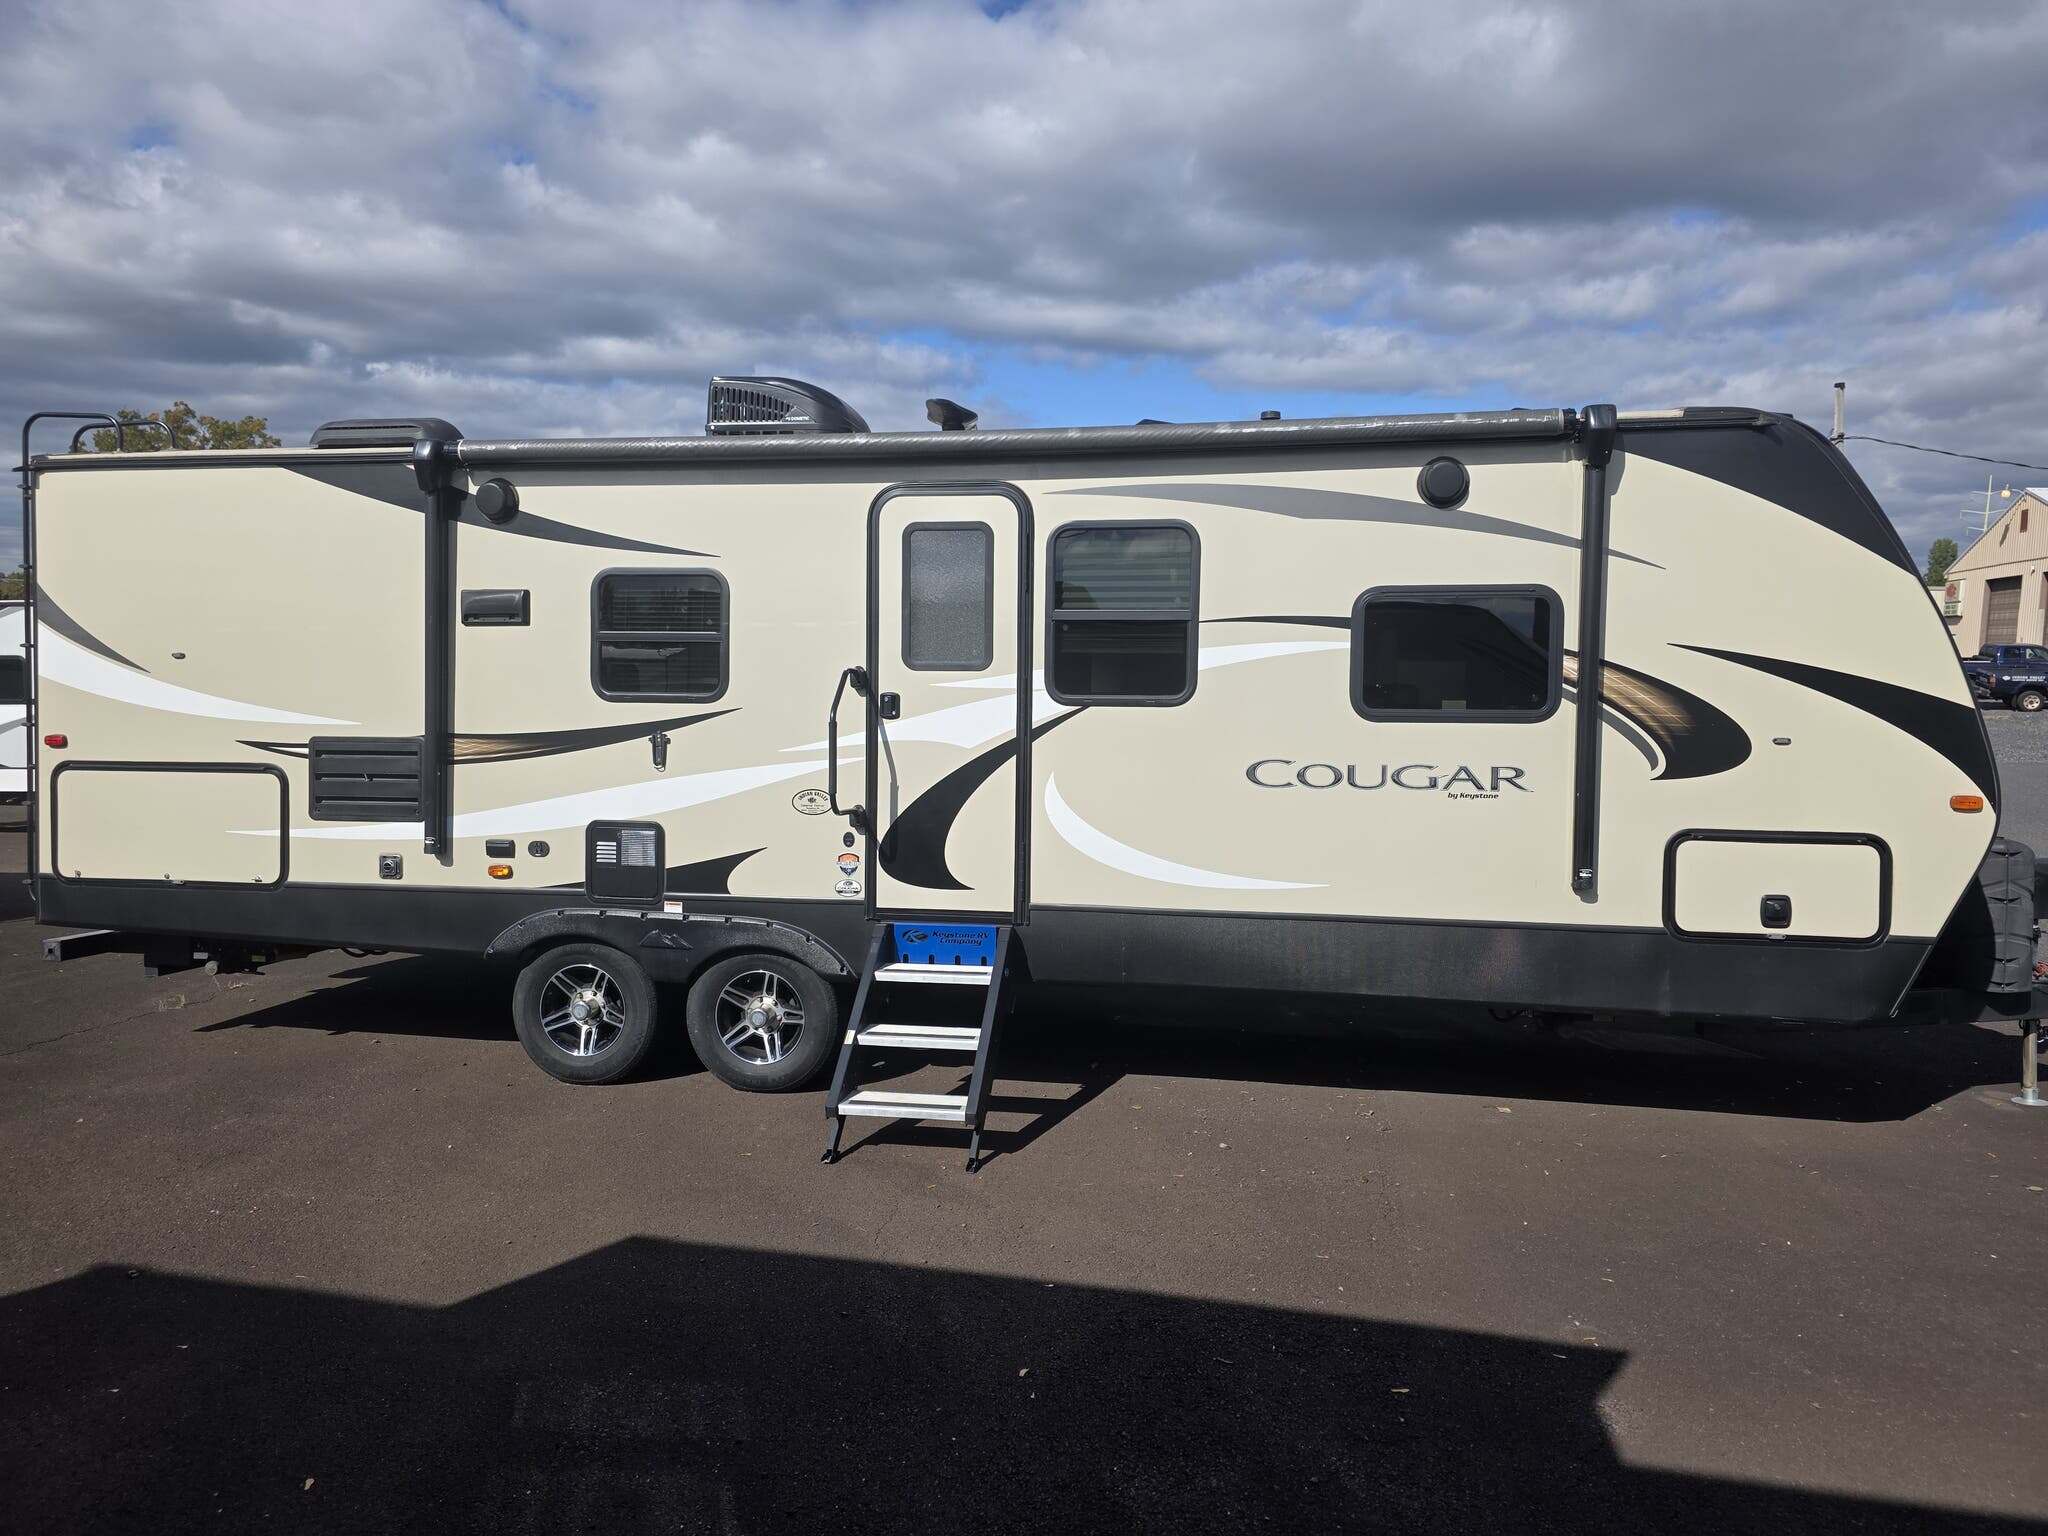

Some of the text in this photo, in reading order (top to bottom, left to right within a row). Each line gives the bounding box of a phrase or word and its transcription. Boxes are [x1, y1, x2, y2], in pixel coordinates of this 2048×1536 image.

[1246, 759, 1534, 792] COUGAR
[1447, 792, 1499, 800] by Keystone
[932, 929, 989, 939] Keystone RV
[939, 937, 982, 946] Company
